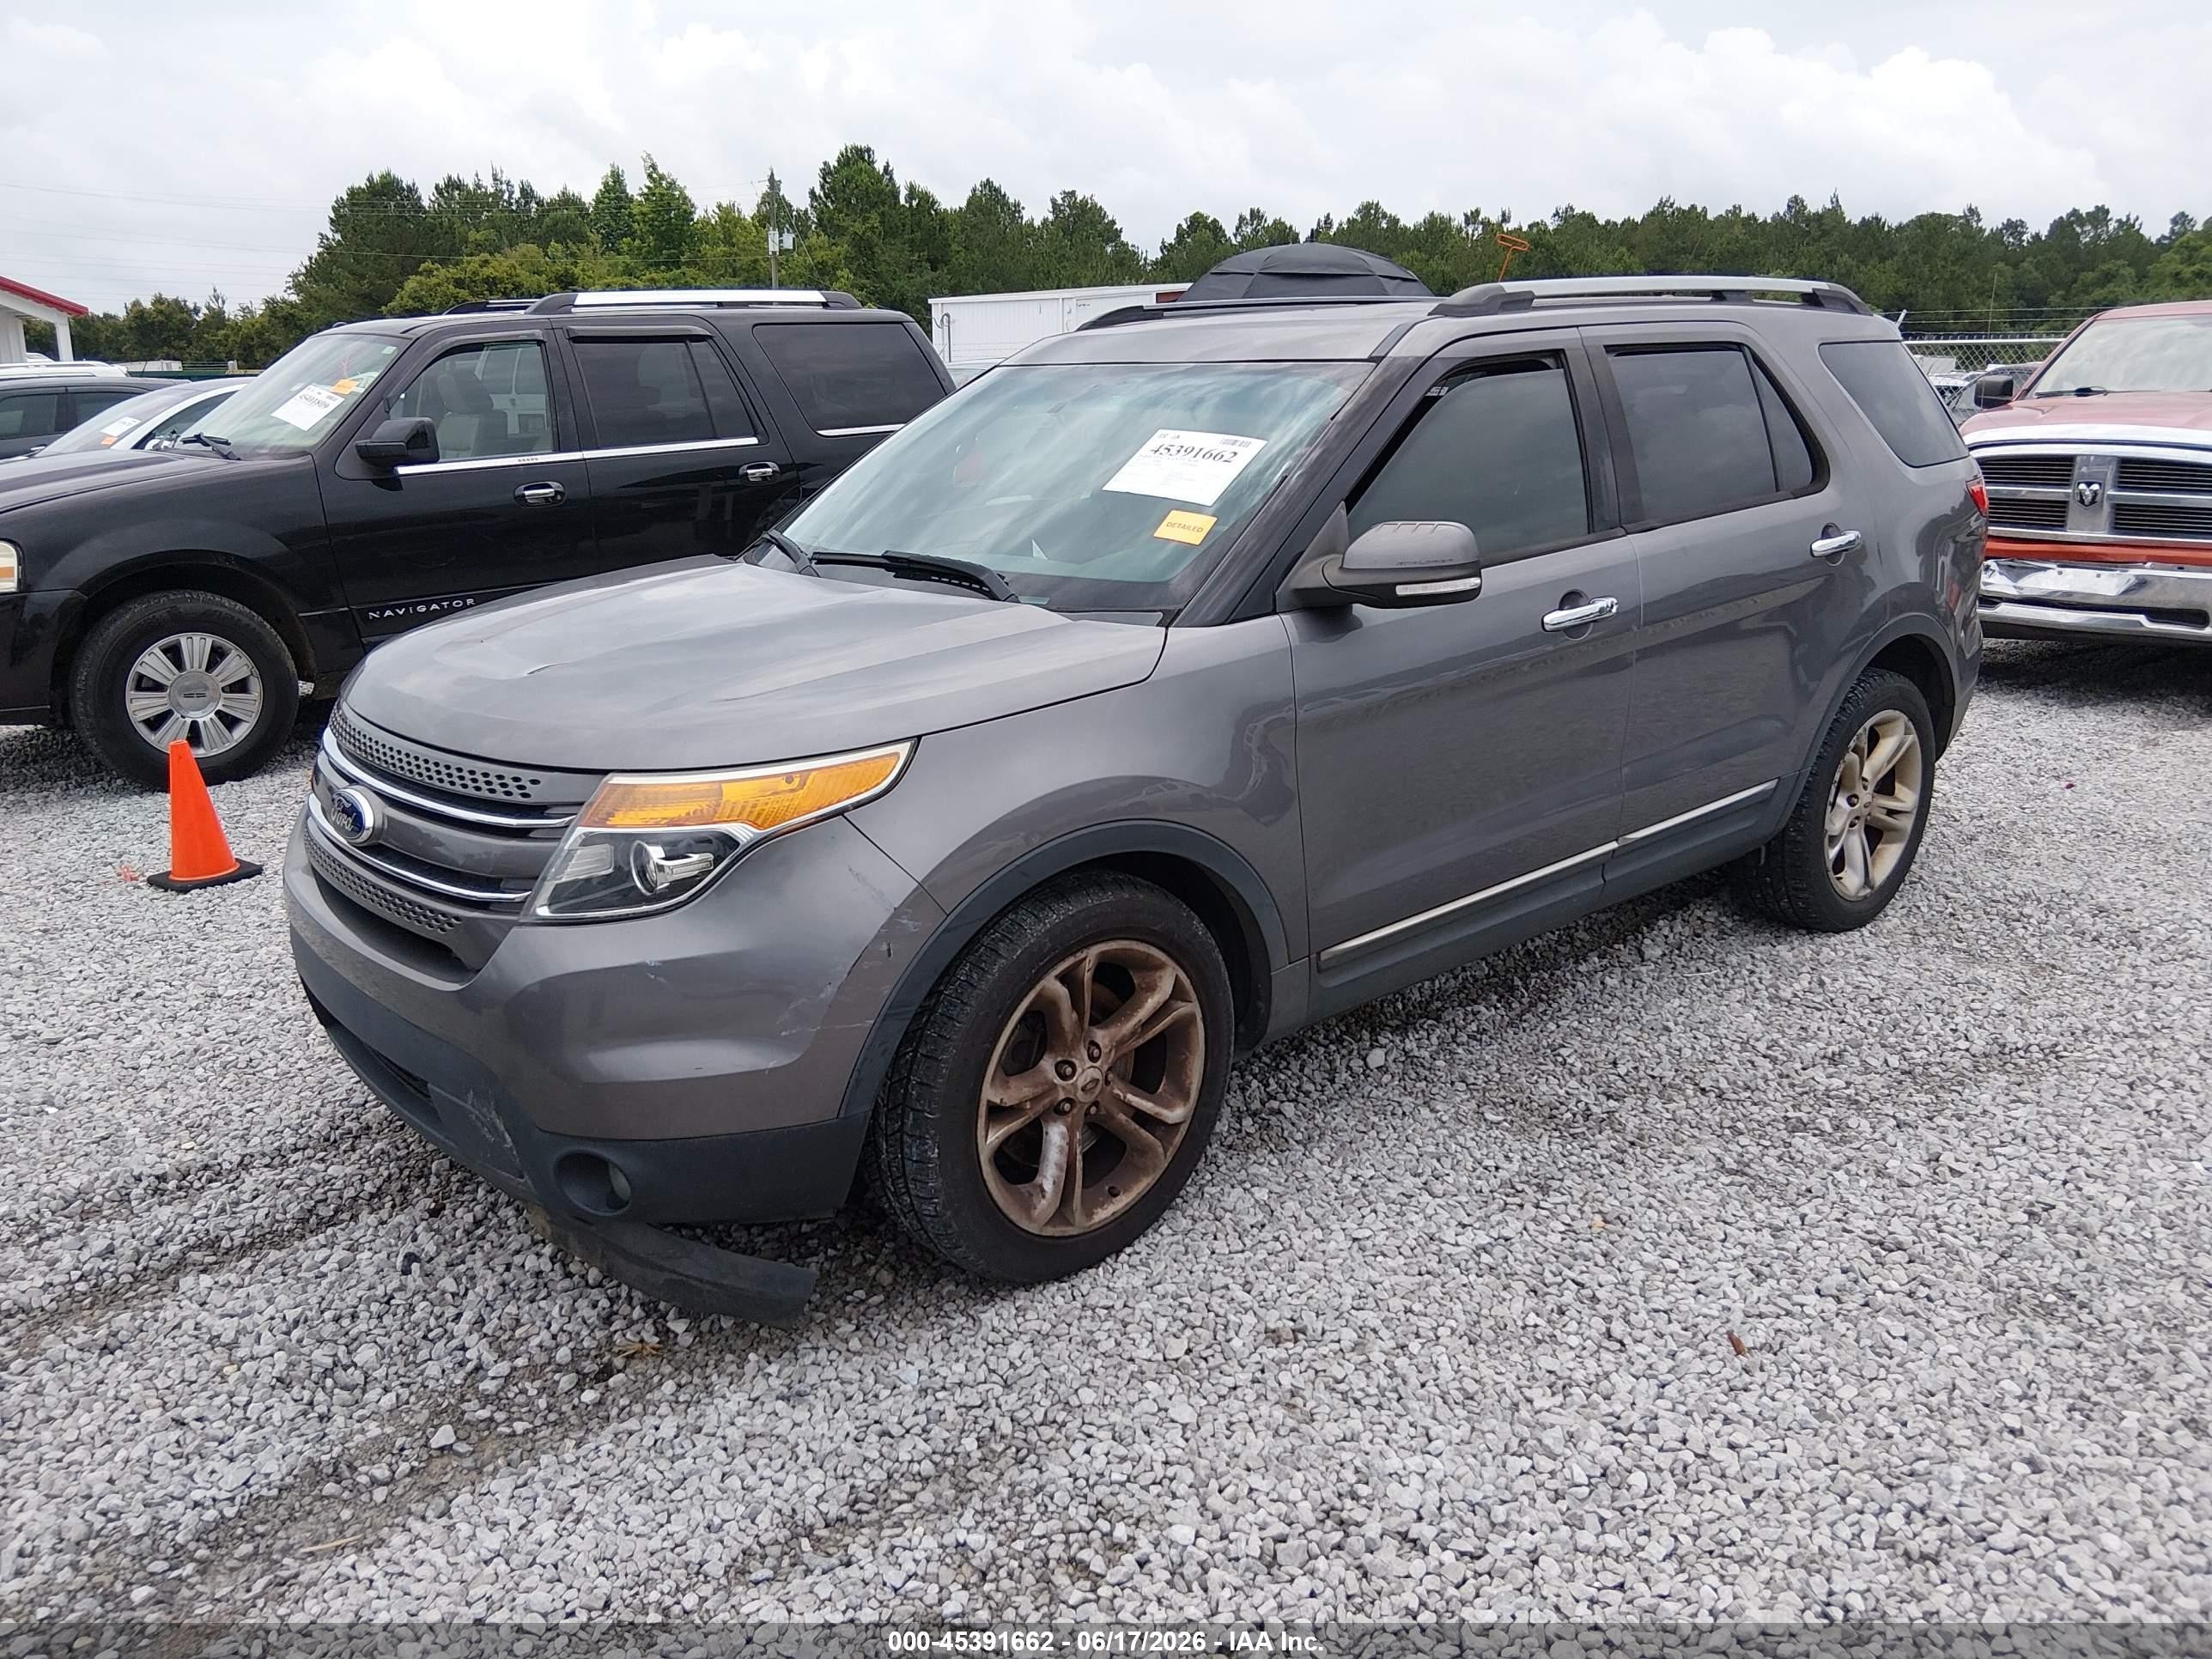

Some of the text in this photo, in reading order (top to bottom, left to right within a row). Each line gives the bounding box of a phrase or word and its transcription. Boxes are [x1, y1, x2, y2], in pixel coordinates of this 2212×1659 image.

[1150, 444, 1239, 464] 45391662
[1166, 521, 1204, 533] DETAILED
[368, 599, 476, 619] NAVIGATOR
[331, 796, 357, 832] Ford
